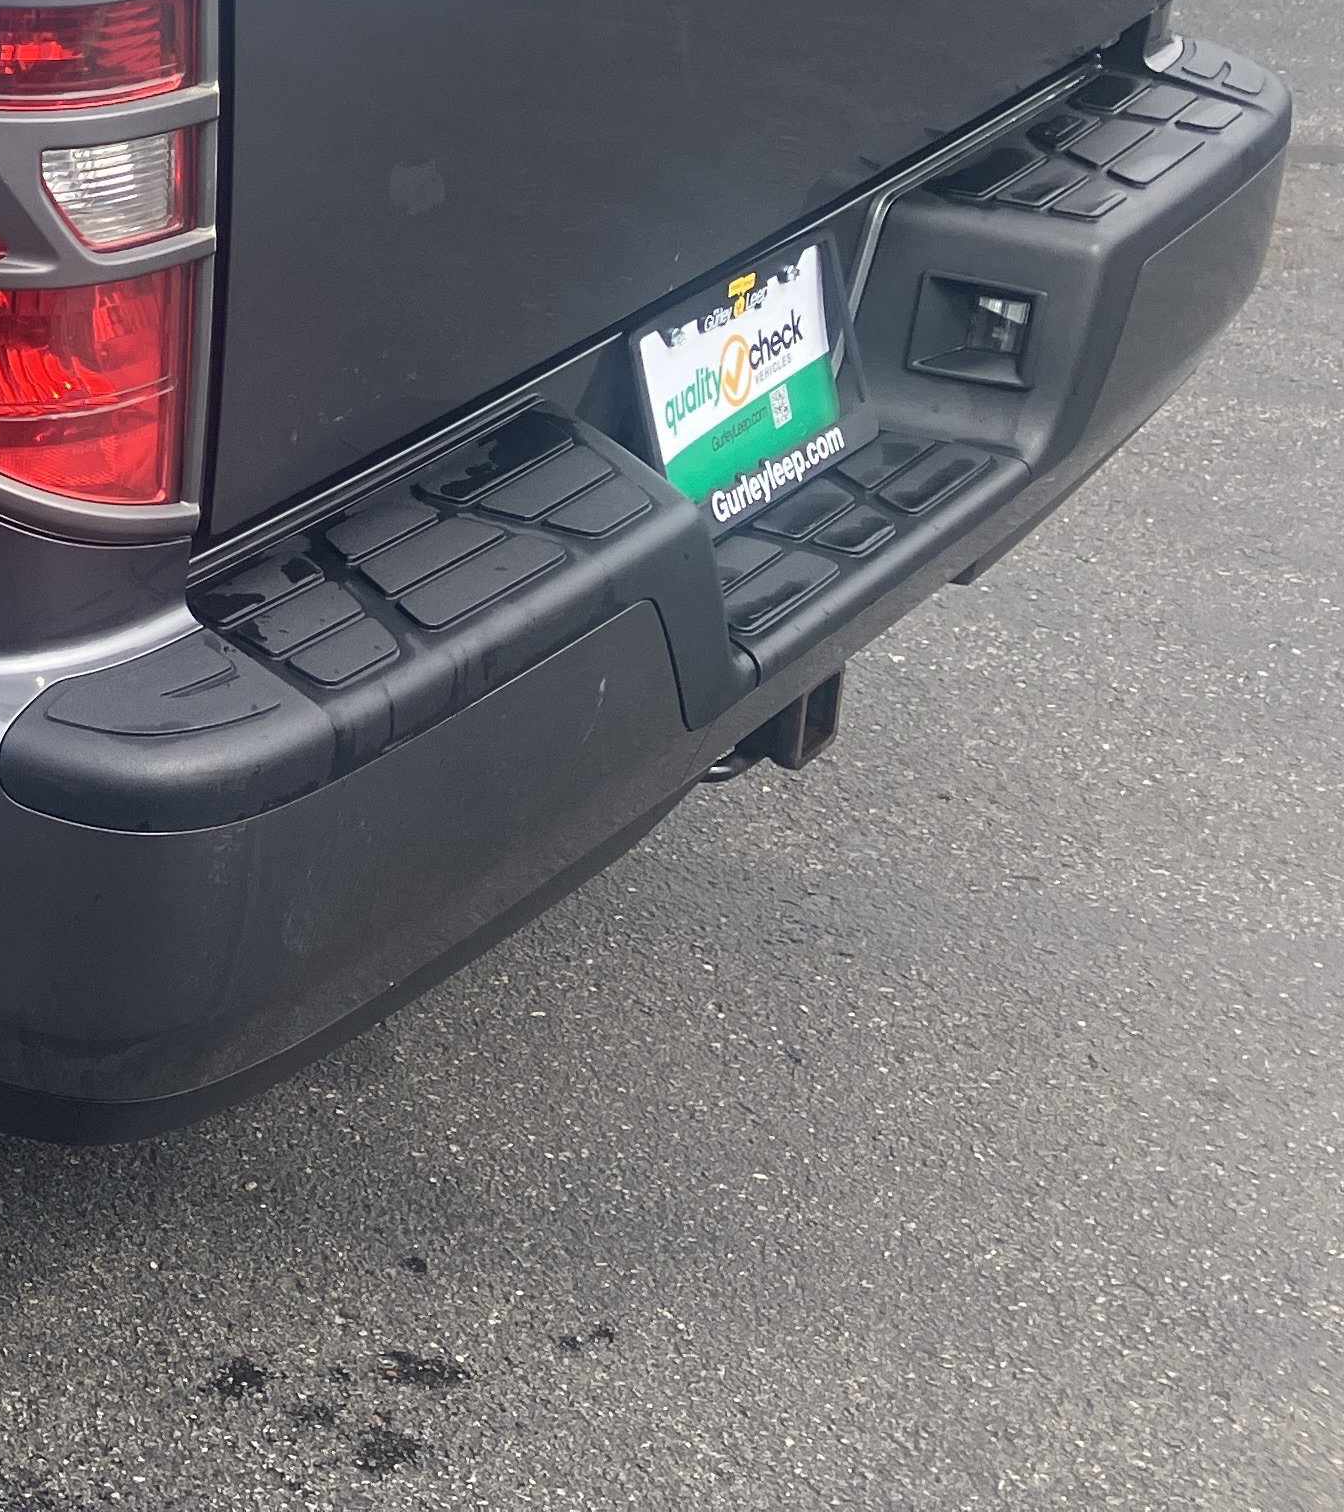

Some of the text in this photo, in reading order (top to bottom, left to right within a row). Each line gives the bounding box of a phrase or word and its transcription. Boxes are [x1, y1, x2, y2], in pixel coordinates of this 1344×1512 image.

[664, 309, 804, 436] quality check
[754, 353, 792, 385] VEHICLES
[711, 425, 845, 523] Gurleyleep.com
